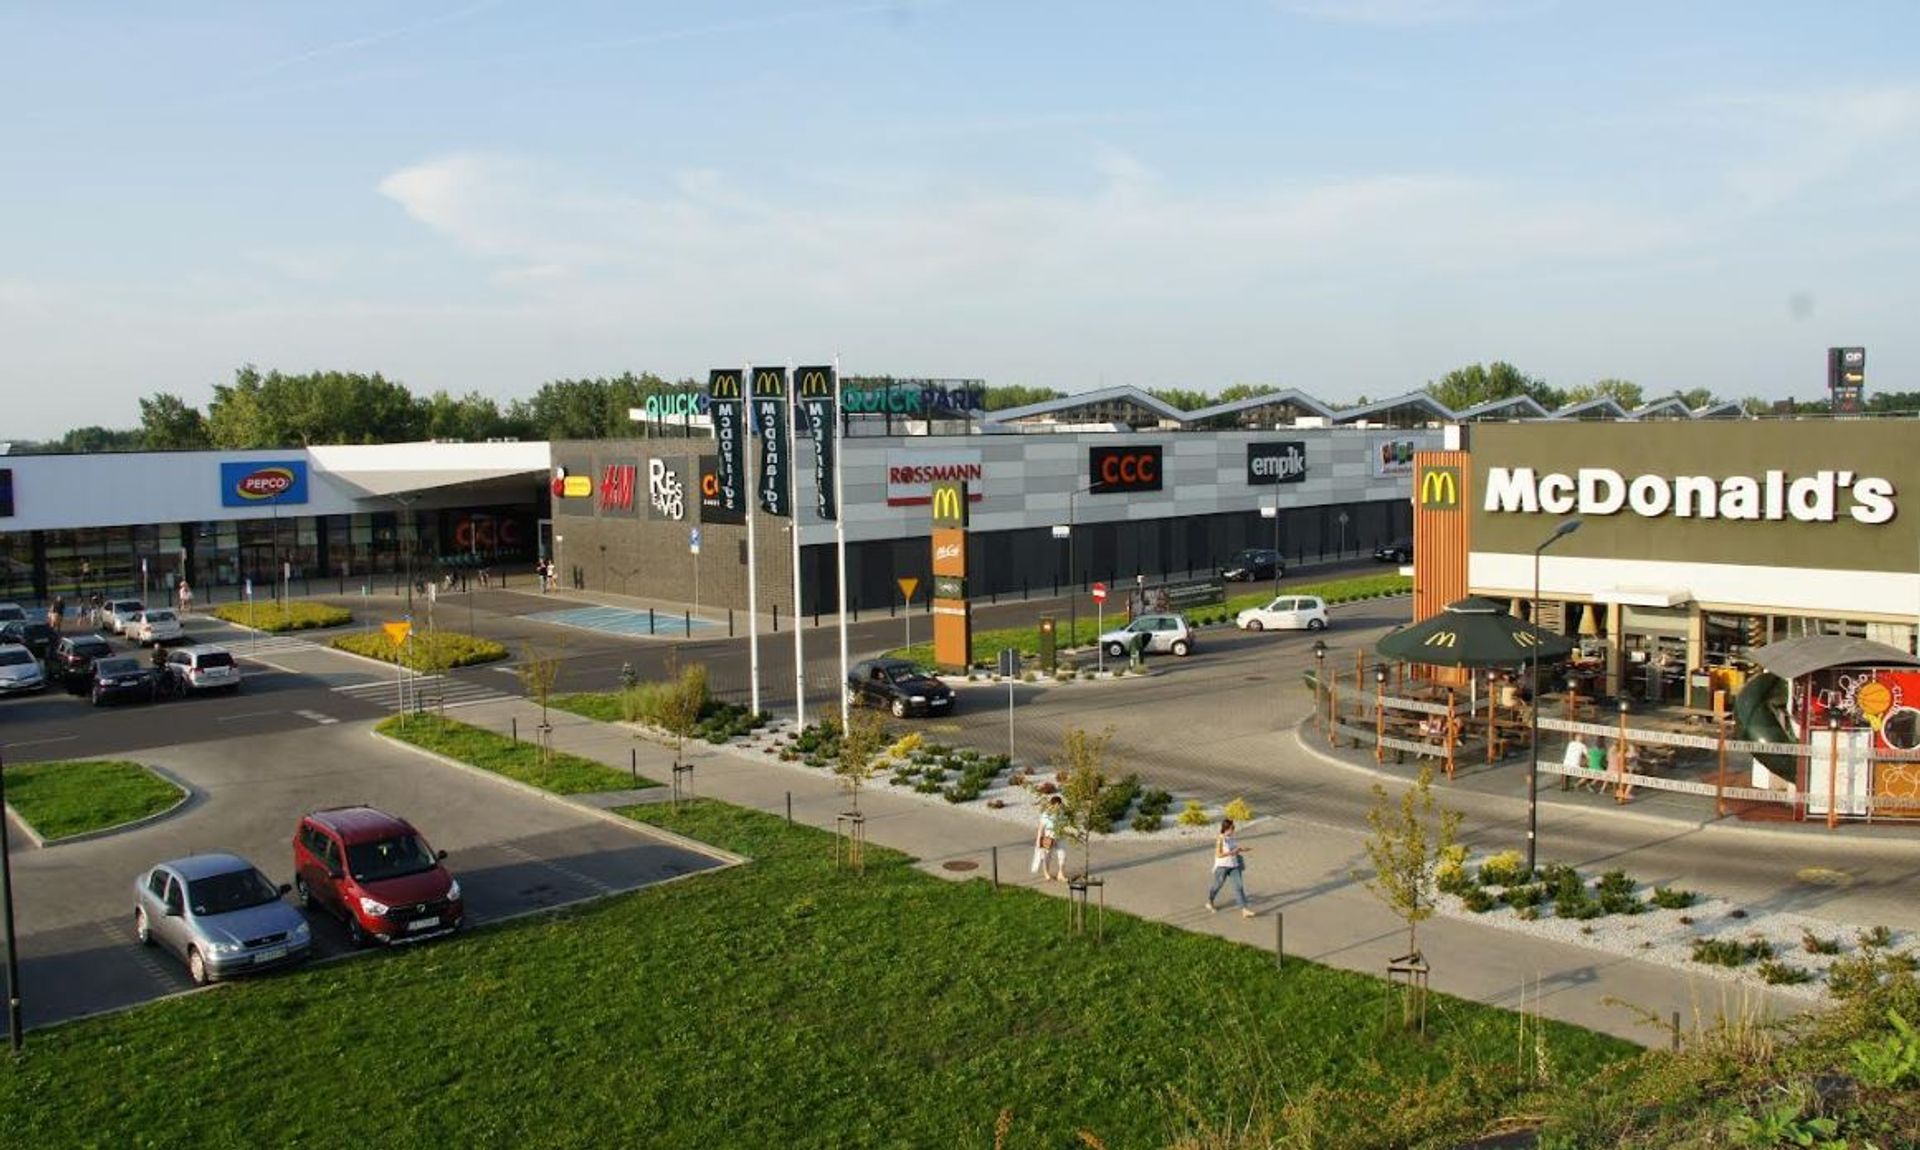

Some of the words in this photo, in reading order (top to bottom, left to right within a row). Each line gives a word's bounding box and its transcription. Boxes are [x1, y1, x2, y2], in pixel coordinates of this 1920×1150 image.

[890, 463, 982, 484] ROSSMANN
[1102, 454, 1155, 484] CCC
[1251, 446, 1303, 479] empik
[246, 478, 286, 490] PEPCO
[1483, 467, 1897, 524] McDonald's
